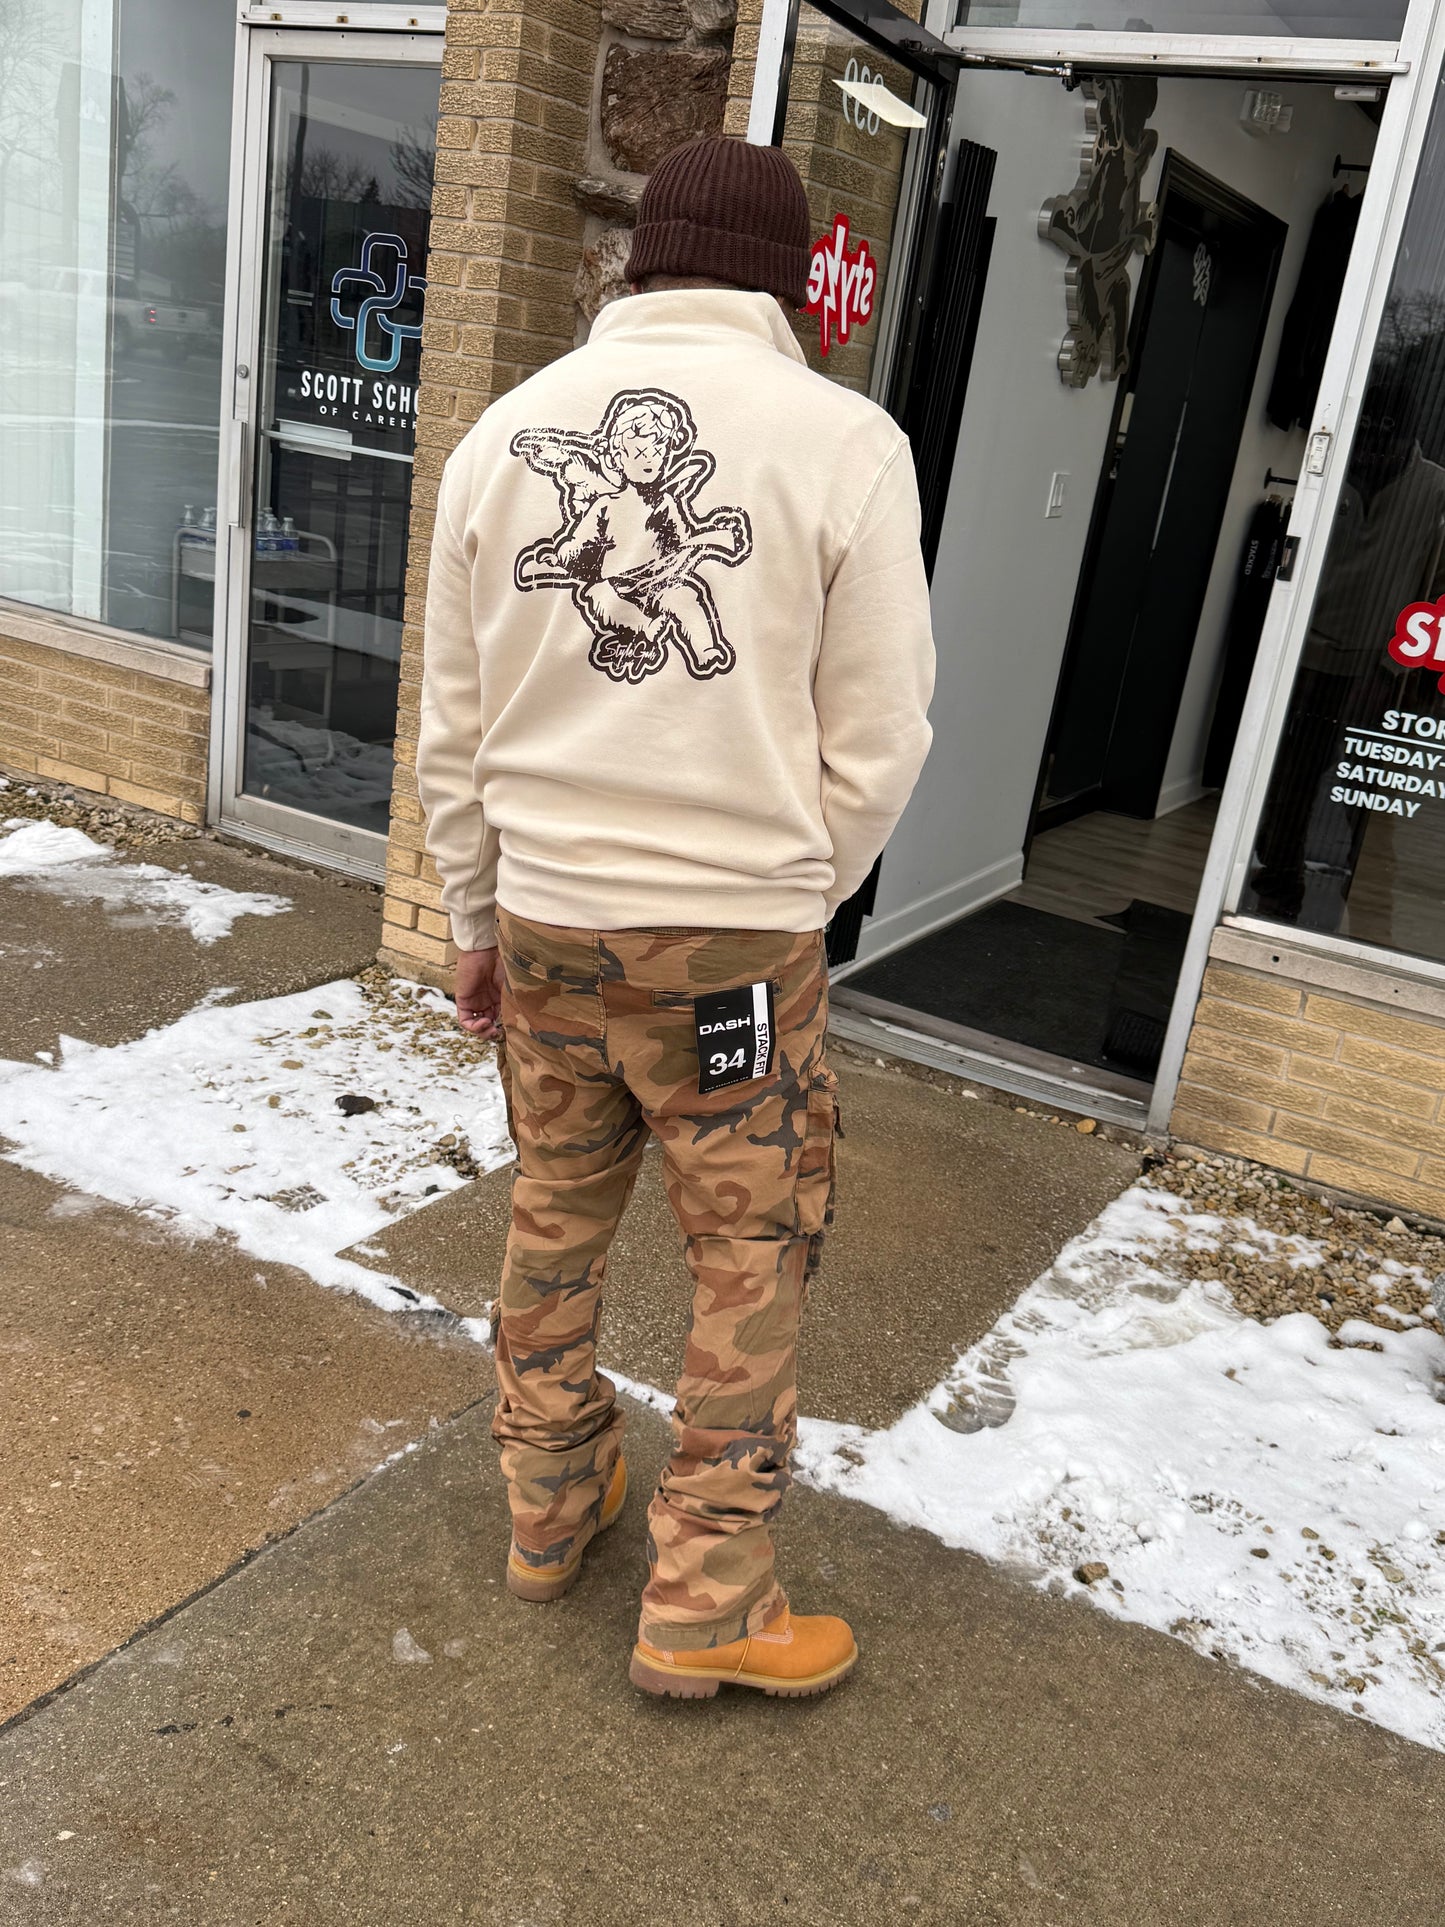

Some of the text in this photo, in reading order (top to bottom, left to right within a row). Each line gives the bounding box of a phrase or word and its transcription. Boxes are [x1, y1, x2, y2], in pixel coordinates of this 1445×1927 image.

[301, 370, 363, 406] SCOTT
[319, 405, 338, 417] OF
[1330, 786, 1421, 818] SUNDAY
[699, 1016, 751, 1035] DASH
[709, 1048, 747, 1076] 34
